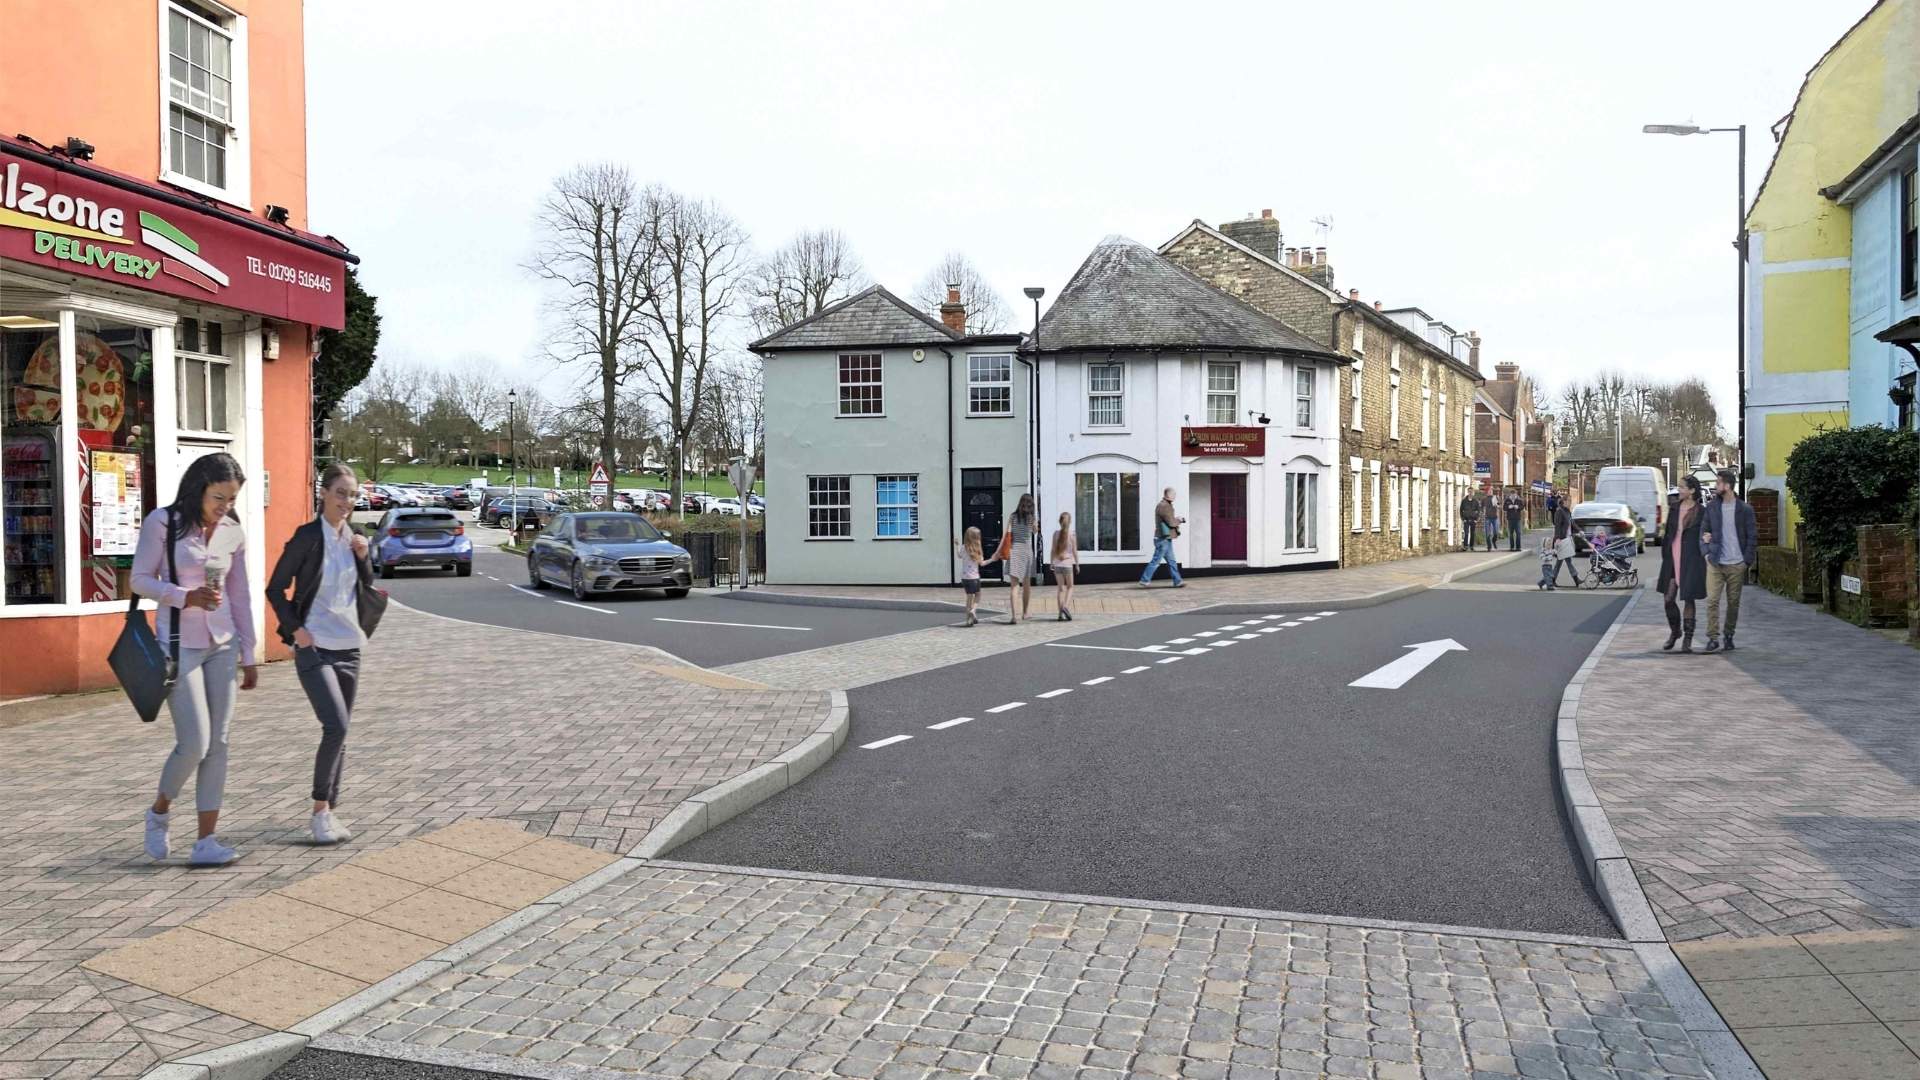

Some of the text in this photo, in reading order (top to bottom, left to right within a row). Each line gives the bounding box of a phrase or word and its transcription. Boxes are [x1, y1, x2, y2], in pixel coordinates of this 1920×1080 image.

[0, 163, 124, 237] lzone
[35, 231, 161, 280] DELIVERY
[246, 256, 332, 293] TEL: 01799 516445
